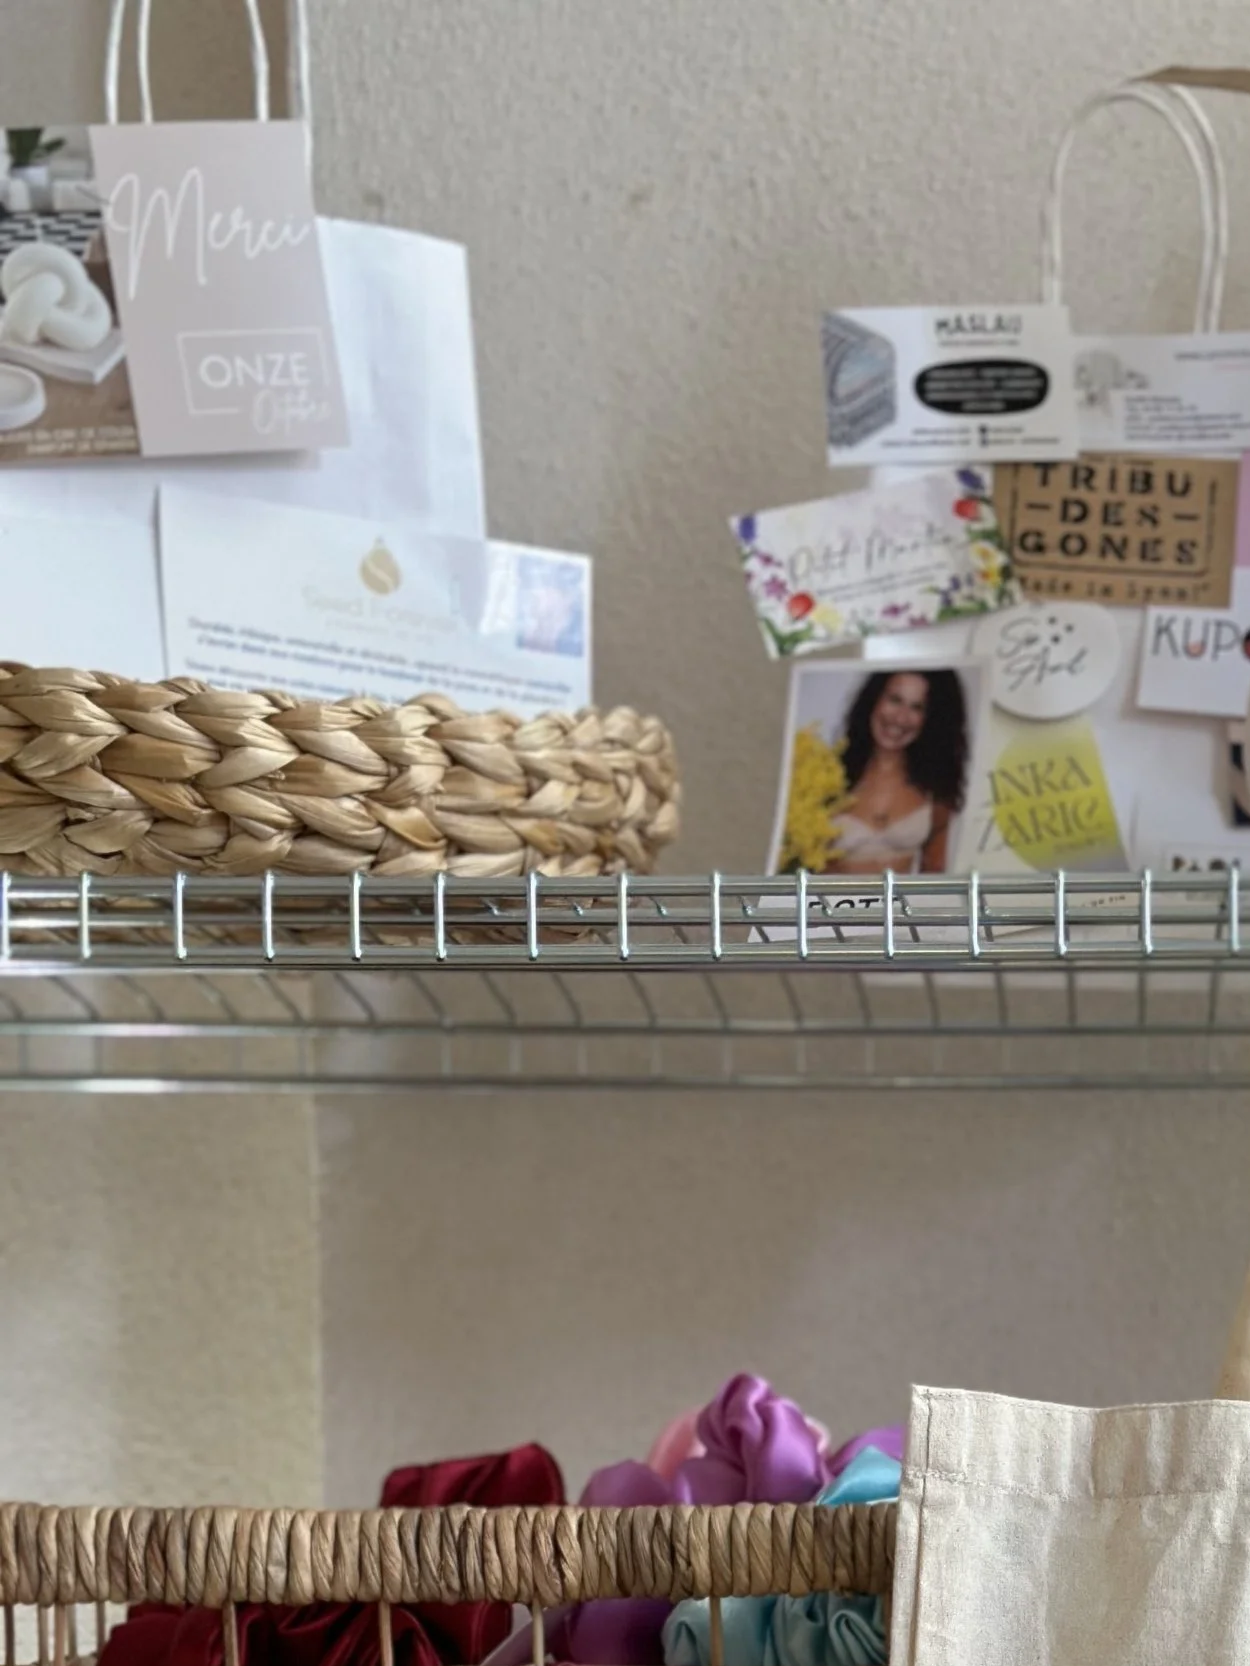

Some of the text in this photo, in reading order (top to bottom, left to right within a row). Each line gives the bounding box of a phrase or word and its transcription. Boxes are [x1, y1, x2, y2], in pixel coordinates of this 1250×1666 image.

[104, 166, 311, 300] Merci
[198, 351, 311, 389] ONZE
[1033, 462, 1193, 498] TRIBU
[1060, 497, 1161, 528] DES
[1018, 530, 1200, 565] GONES
